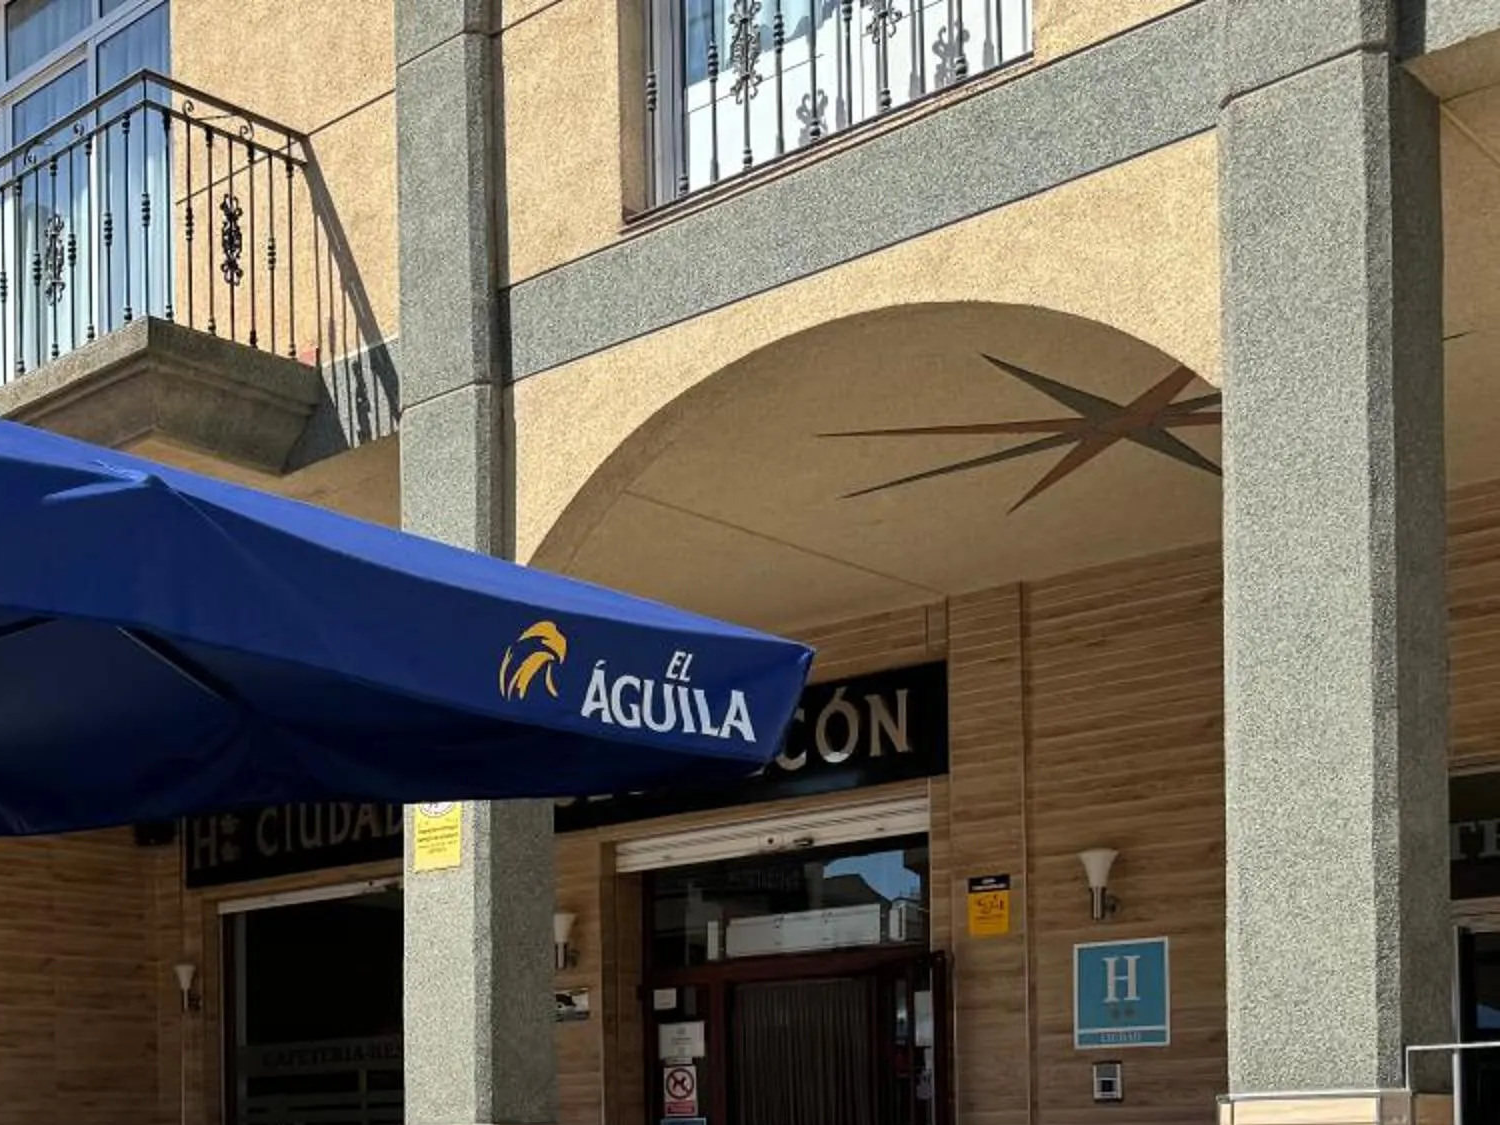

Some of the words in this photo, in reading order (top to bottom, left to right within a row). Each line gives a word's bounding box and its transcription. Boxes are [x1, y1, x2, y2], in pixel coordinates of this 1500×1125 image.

[666, 650, 694, 682] EL
[580, 659, 757, 743] ÁGUILA
[1101, 955, 1141, 1004] H
